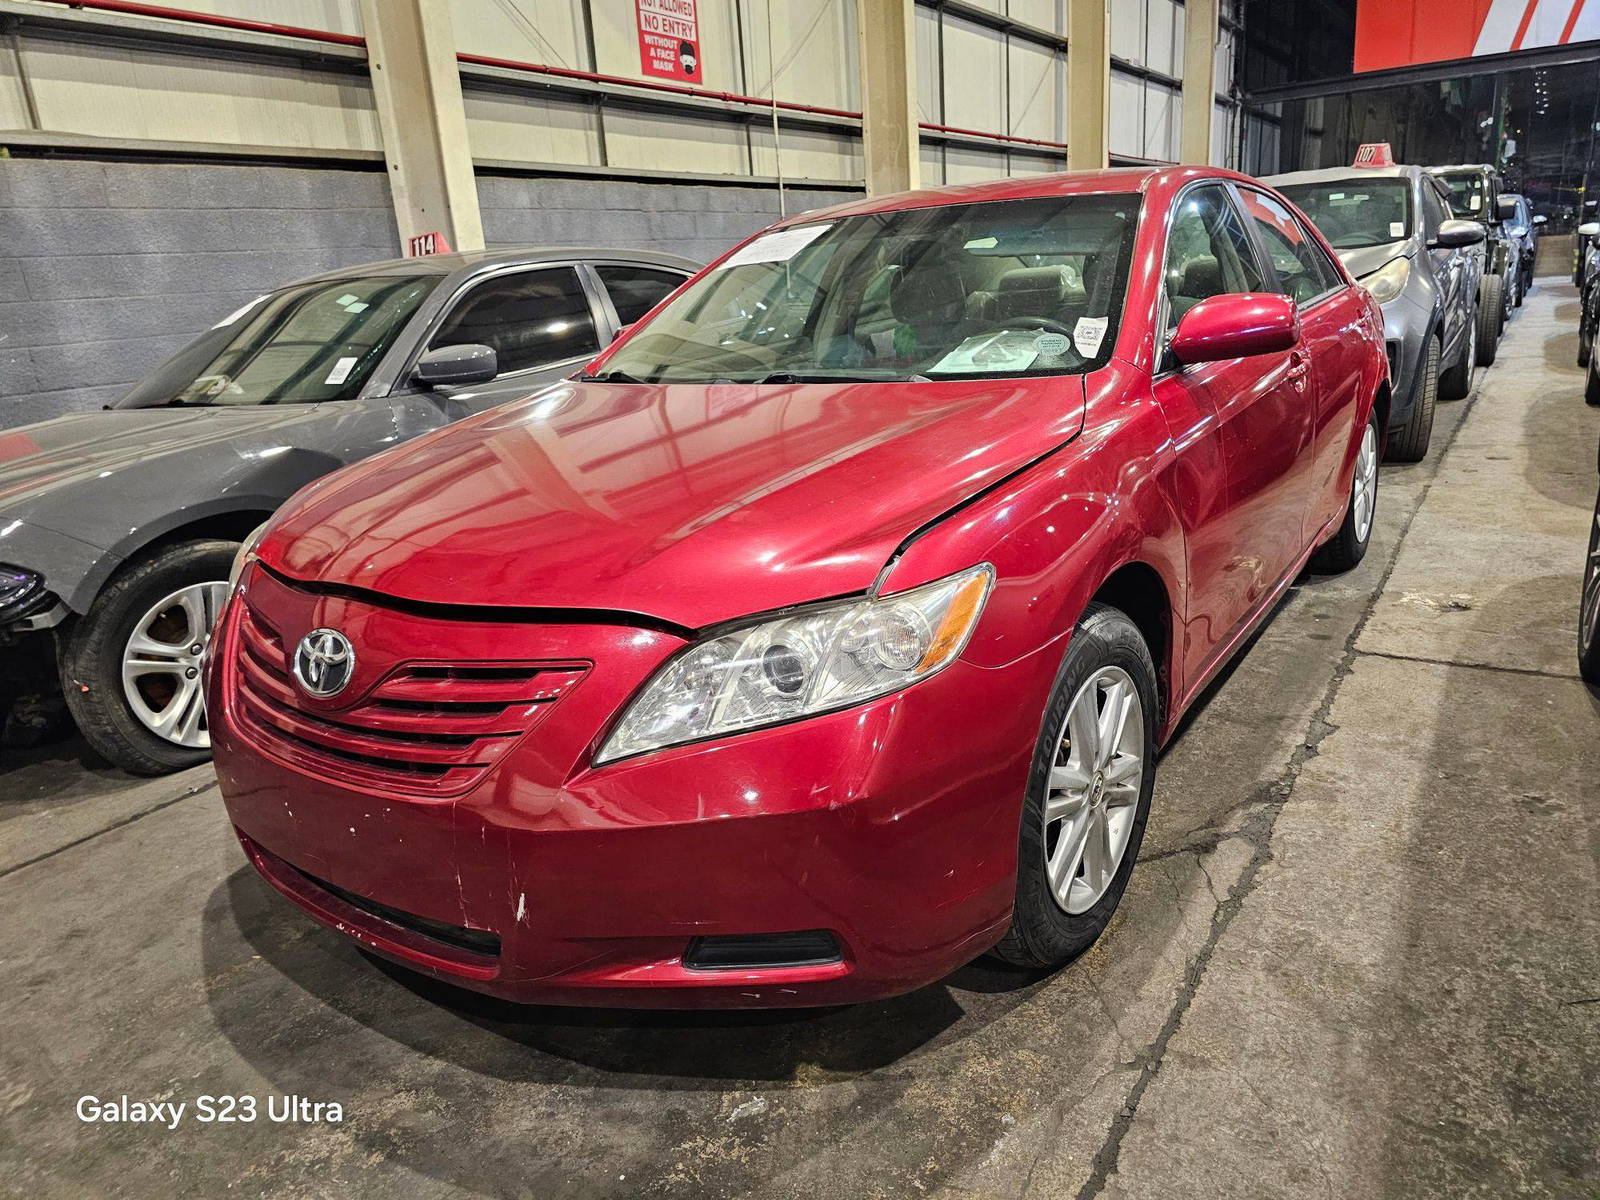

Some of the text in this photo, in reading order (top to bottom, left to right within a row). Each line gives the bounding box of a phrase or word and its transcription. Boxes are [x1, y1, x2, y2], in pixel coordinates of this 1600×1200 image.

[659, 0, 693, 17] ALLOWED
[643, 14, 693, 38] NO ENTRY
[643, 34, 678, 50] WITHOUT
[650, 47, 676, 61] A FACE
[652, 59, 675, 73] MASK
[1358, 146, 1376, 162] 107
[413, 234, 434, 257] 114
[1037, 655, 1085, 776] TOURING
